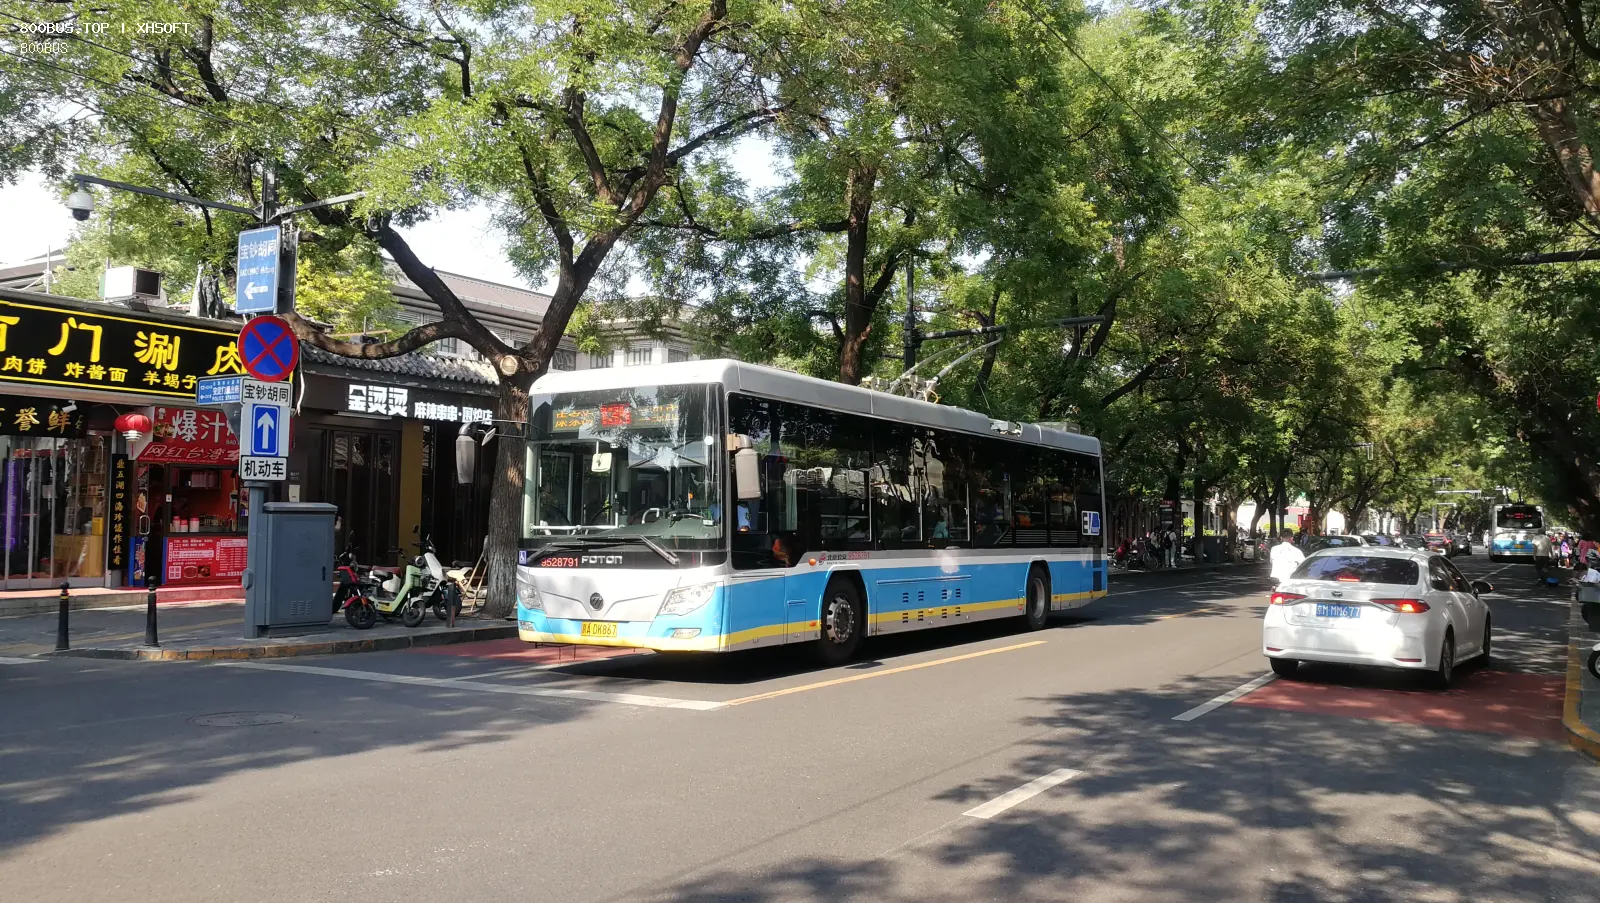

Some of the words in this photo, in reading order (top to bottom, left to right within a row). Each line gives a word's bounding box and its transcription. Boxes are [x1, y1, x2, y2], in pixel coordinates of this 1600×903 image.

[240, 239, 276, 260] 宝钞胡同
[1, 355, 47, 375] 肉饼
[64, 361, 128, 382] 炸酱面
[142, 371, 197, 390] 羊蝎子
[244, 383, 289, 403] 宝钞胡同
[0, 406, 72, 434] 誉鲜
[244, 460, 284, 478] 机动车
[541, 557, 579, 567] 9528791
[581, 555, 623, 565] FOTON
